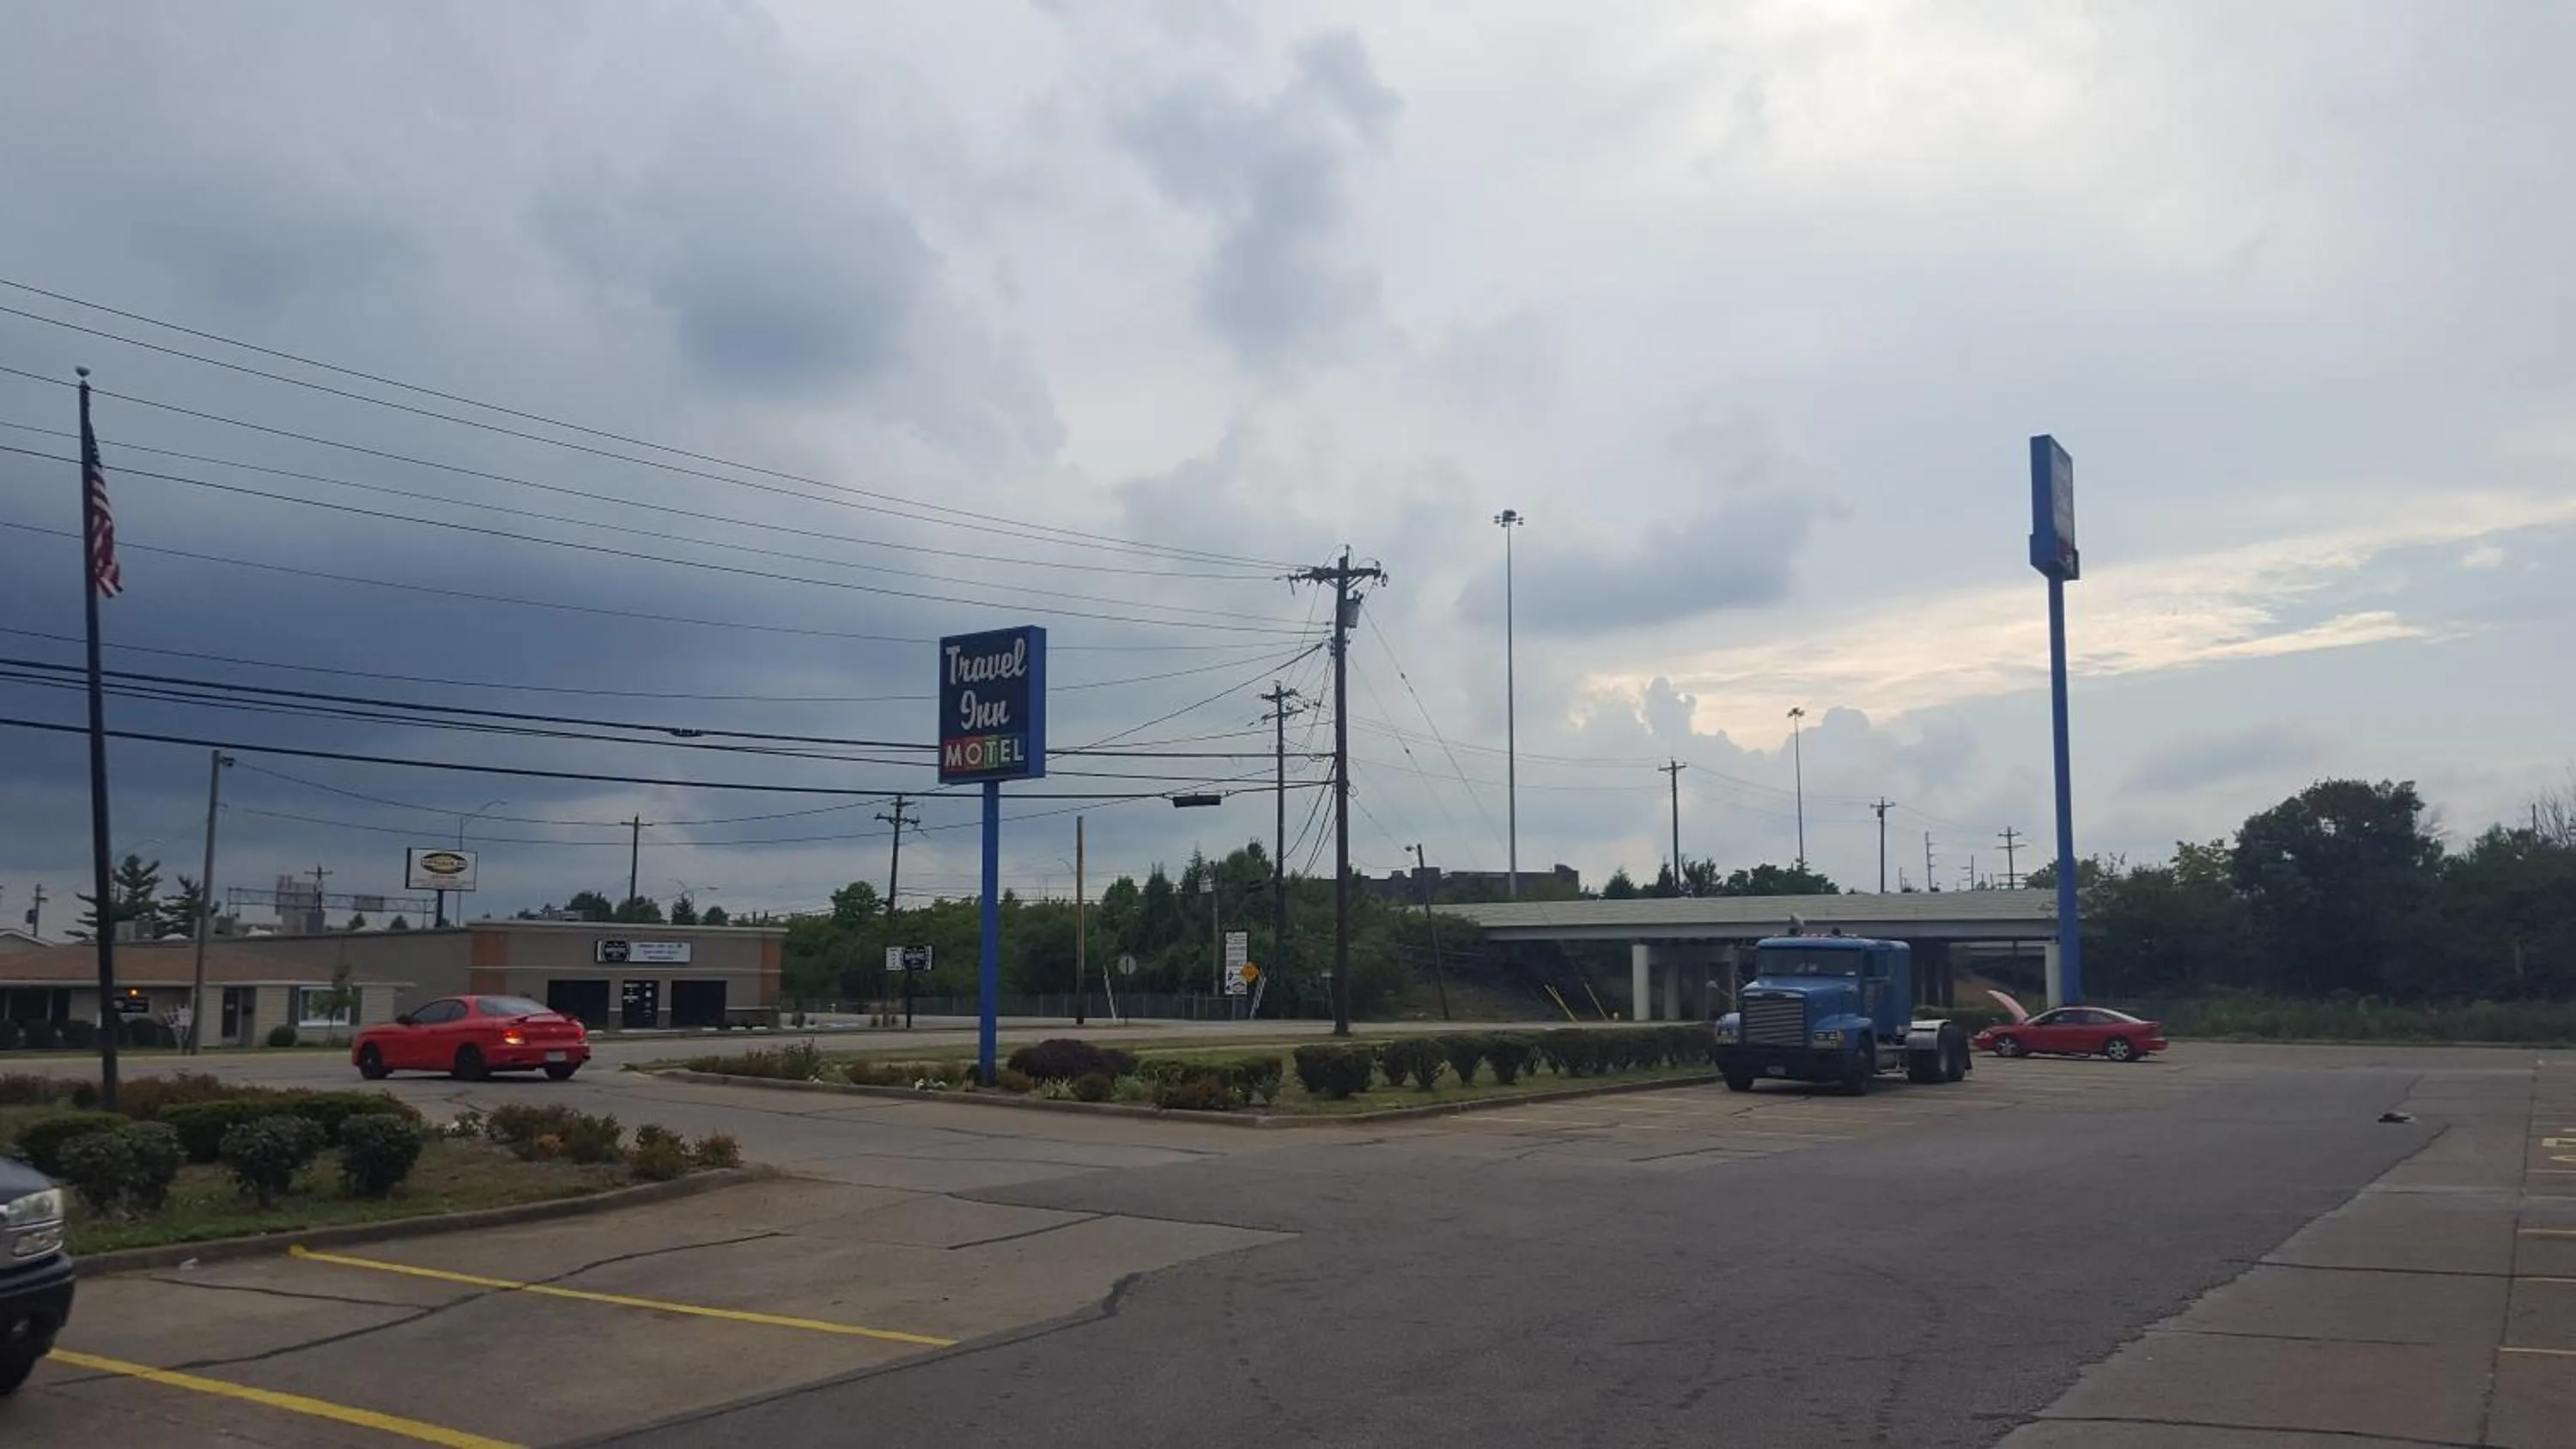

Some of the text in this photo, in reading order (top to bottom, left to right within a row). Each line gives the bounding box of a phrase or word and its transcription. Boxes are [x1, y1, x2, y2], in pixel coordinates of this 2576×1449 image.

[945, 638, 1027, 685] Travel
[960, 689, 1010, 730] Inn
[945, 738, 1024, 767] MOTEL
